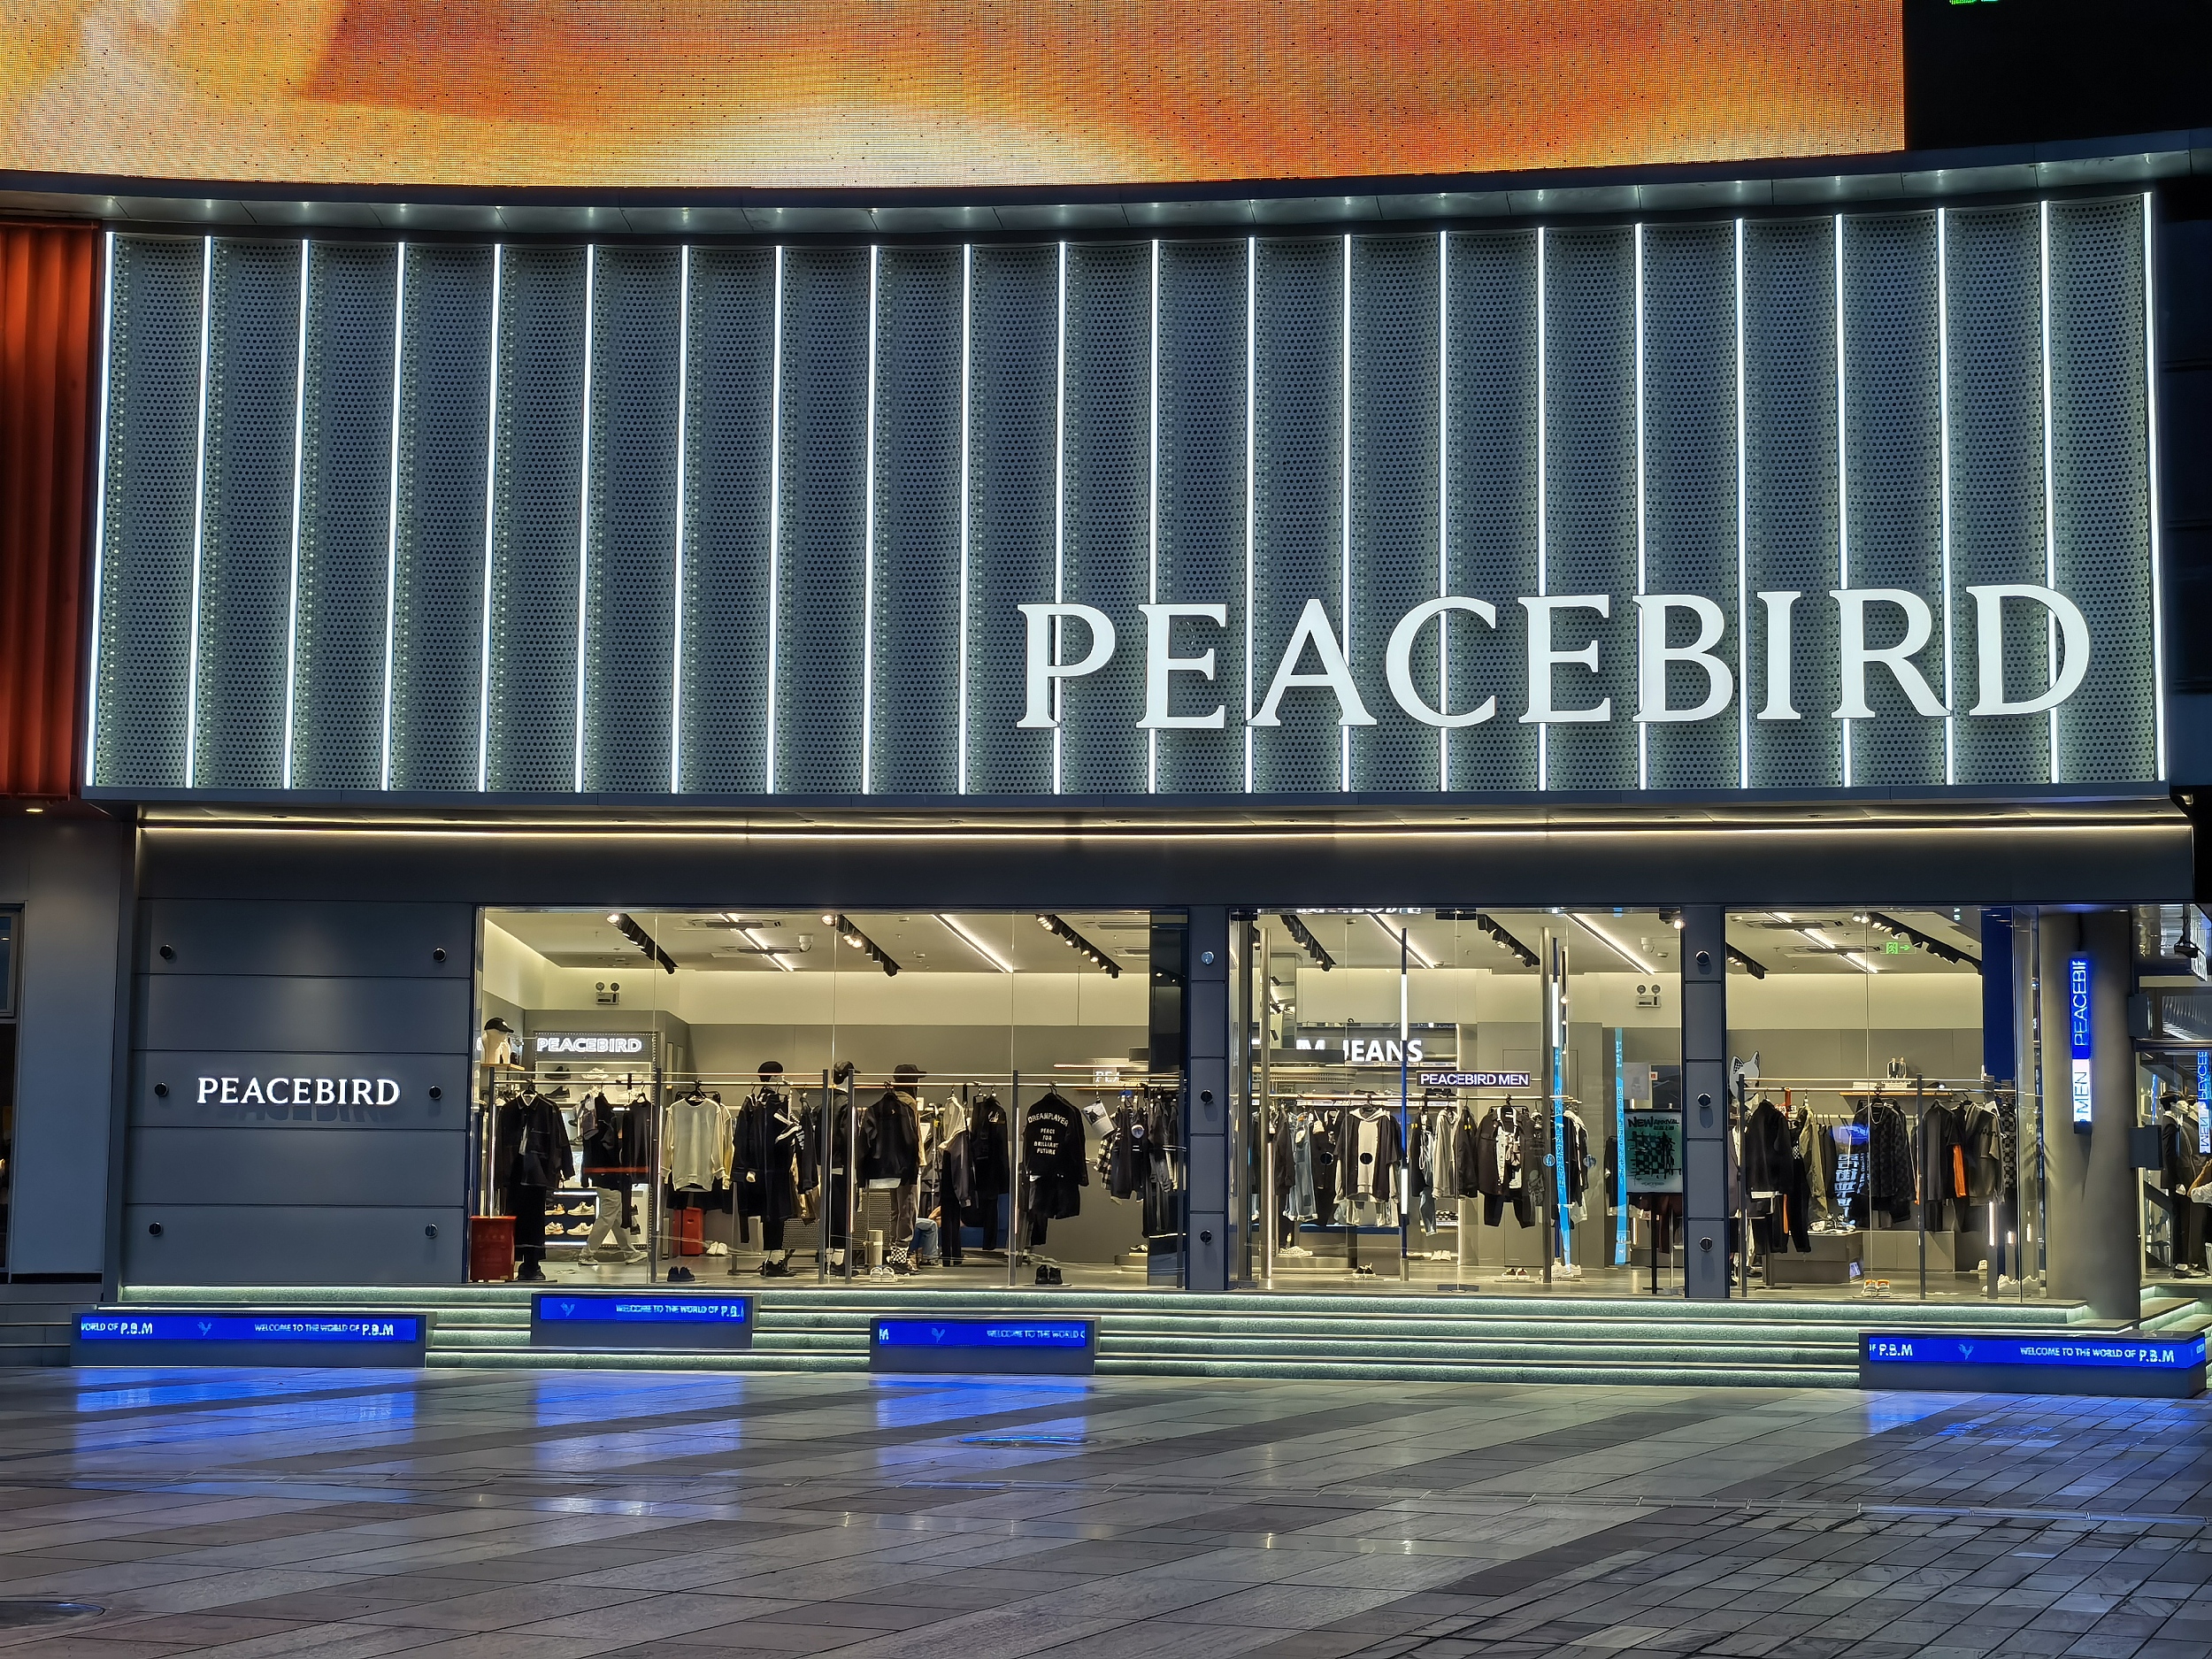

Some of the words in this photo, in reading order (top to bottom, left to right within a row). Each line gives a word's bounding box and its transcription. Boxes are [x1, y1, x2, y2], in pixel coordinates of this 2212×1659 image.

[1016, 584, 2090, 729] PEACEBIRD
[536, 1037, 642, 1053] PEACEBIRD
[1420, 1073, 1497, 1085] PEACEBIRD
[1498, 1074, 1529, 1086] MEN
[196, 1077, 401, 1105] PEACEBIRD
[2075, 1071, 2090, 1114] MEN
[1628, 1116, 1654, 1128] NEW
[120, 1323, 153, 1335] P.B.M
[362, 1325, 394, 1336] P.B.M
[1878, 1343, 1913, 1356] P.B.M
[2020, 1347, 2061, 1356] WELCOME
[2062, 1348, 2074, 1356] TO
[2076, 1348, 2091, 1357] THE
[2093, 1348, 2123, 1357] WORLD
[2124, 1349, 2137, 1358] OF
[2139, 1349, 2175, 1363] P.B.M
